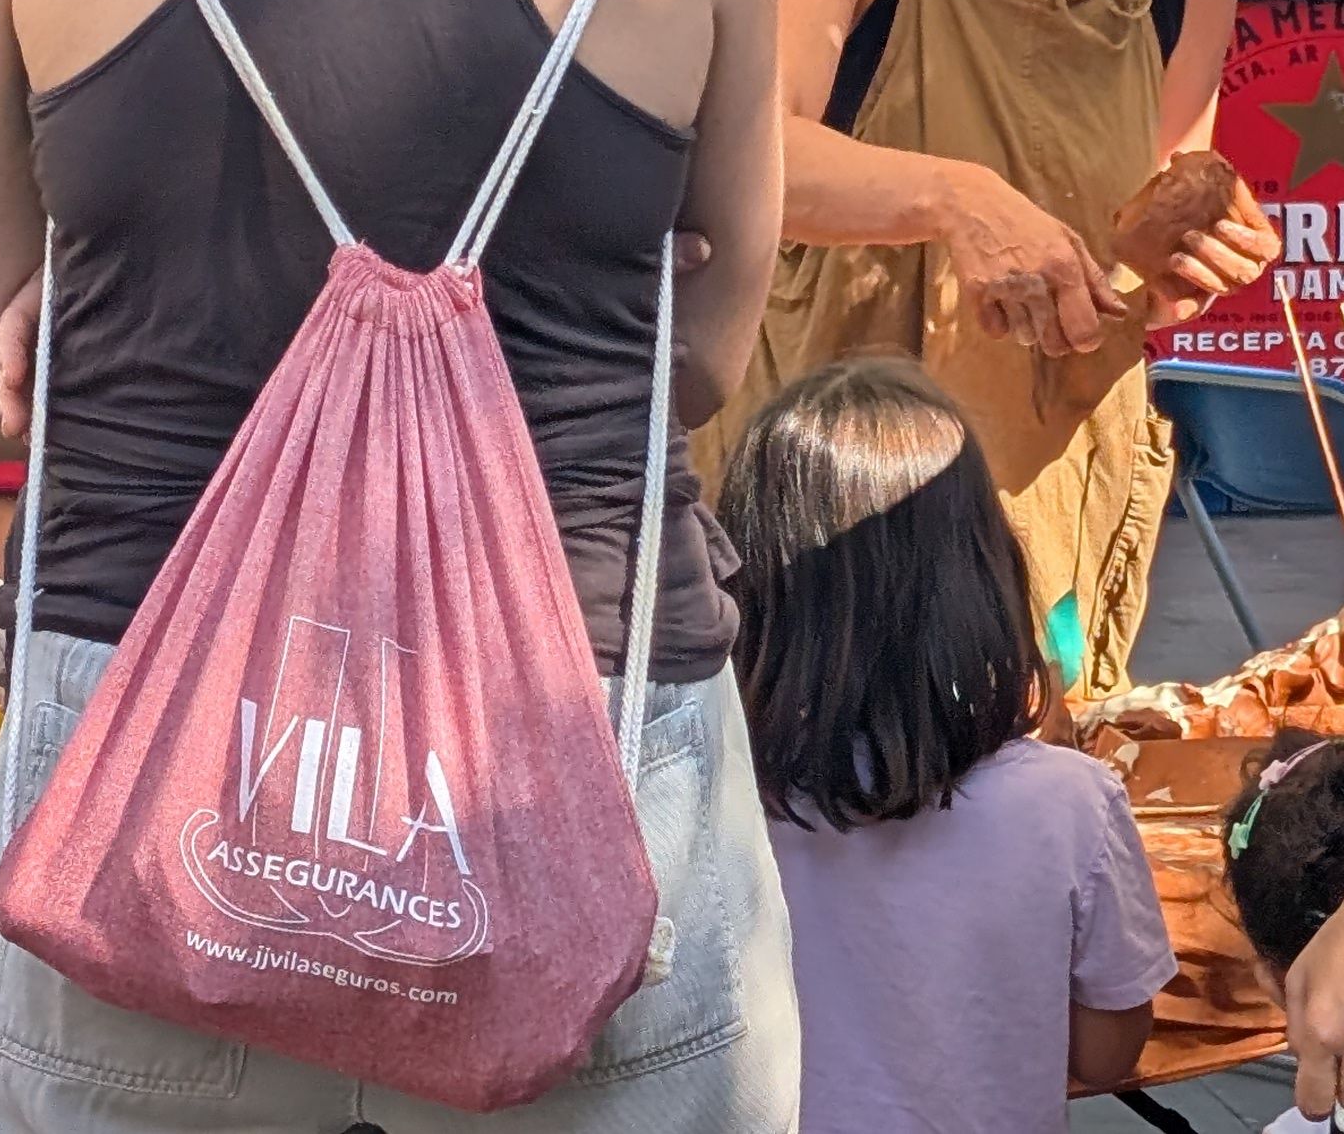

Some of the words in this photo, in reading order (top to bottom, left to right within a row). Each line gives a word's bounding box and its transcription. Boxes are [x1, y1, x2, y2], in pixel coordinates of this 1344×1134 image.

[237, 697, 473, 876] VILA
[206, 839, 462, 929] ASSEGURANCES
[185, 929, 458, 1005] www.jjvilaseguros.com
